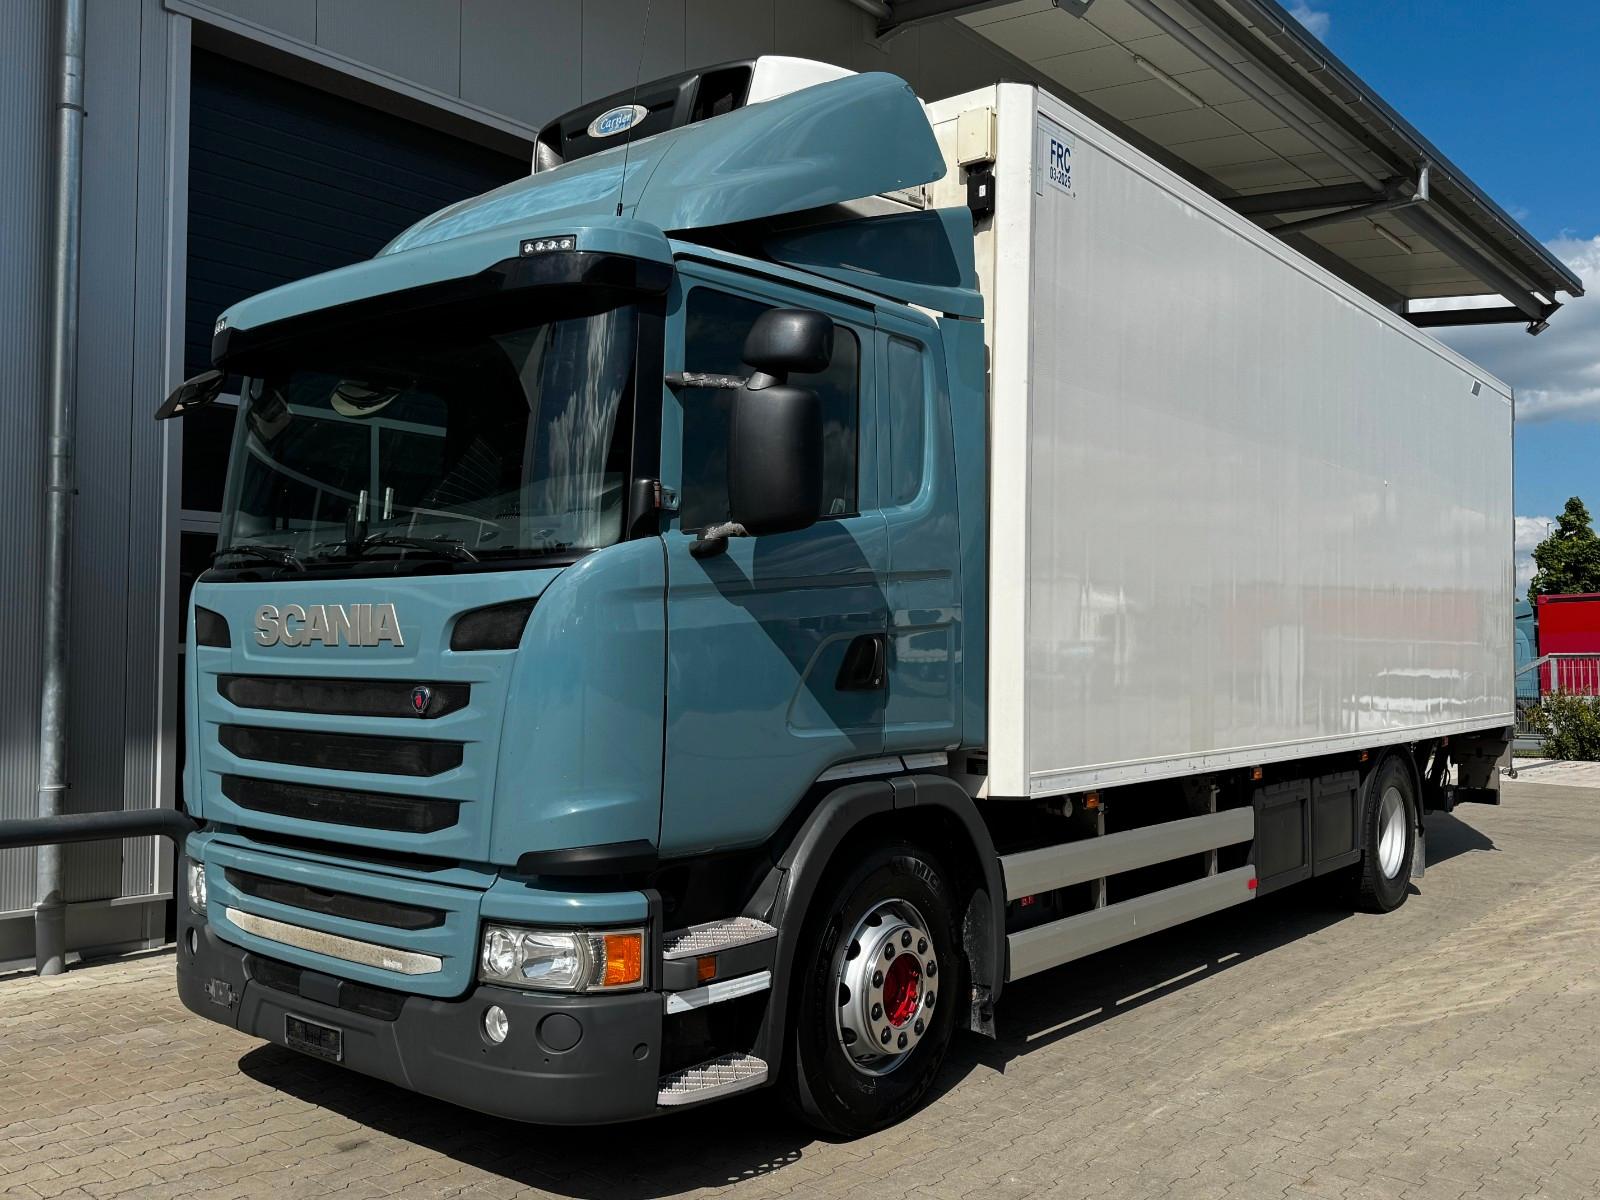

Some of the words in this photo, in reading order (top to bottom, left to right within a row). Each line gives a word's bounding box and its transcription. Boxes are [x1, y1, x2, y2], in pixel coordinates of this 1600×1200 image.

[1050, 138, 1071, 174] FRC
[1050, 166, 1071, 189] 03-2025
[254, 603, 404, 647] SCANIA
